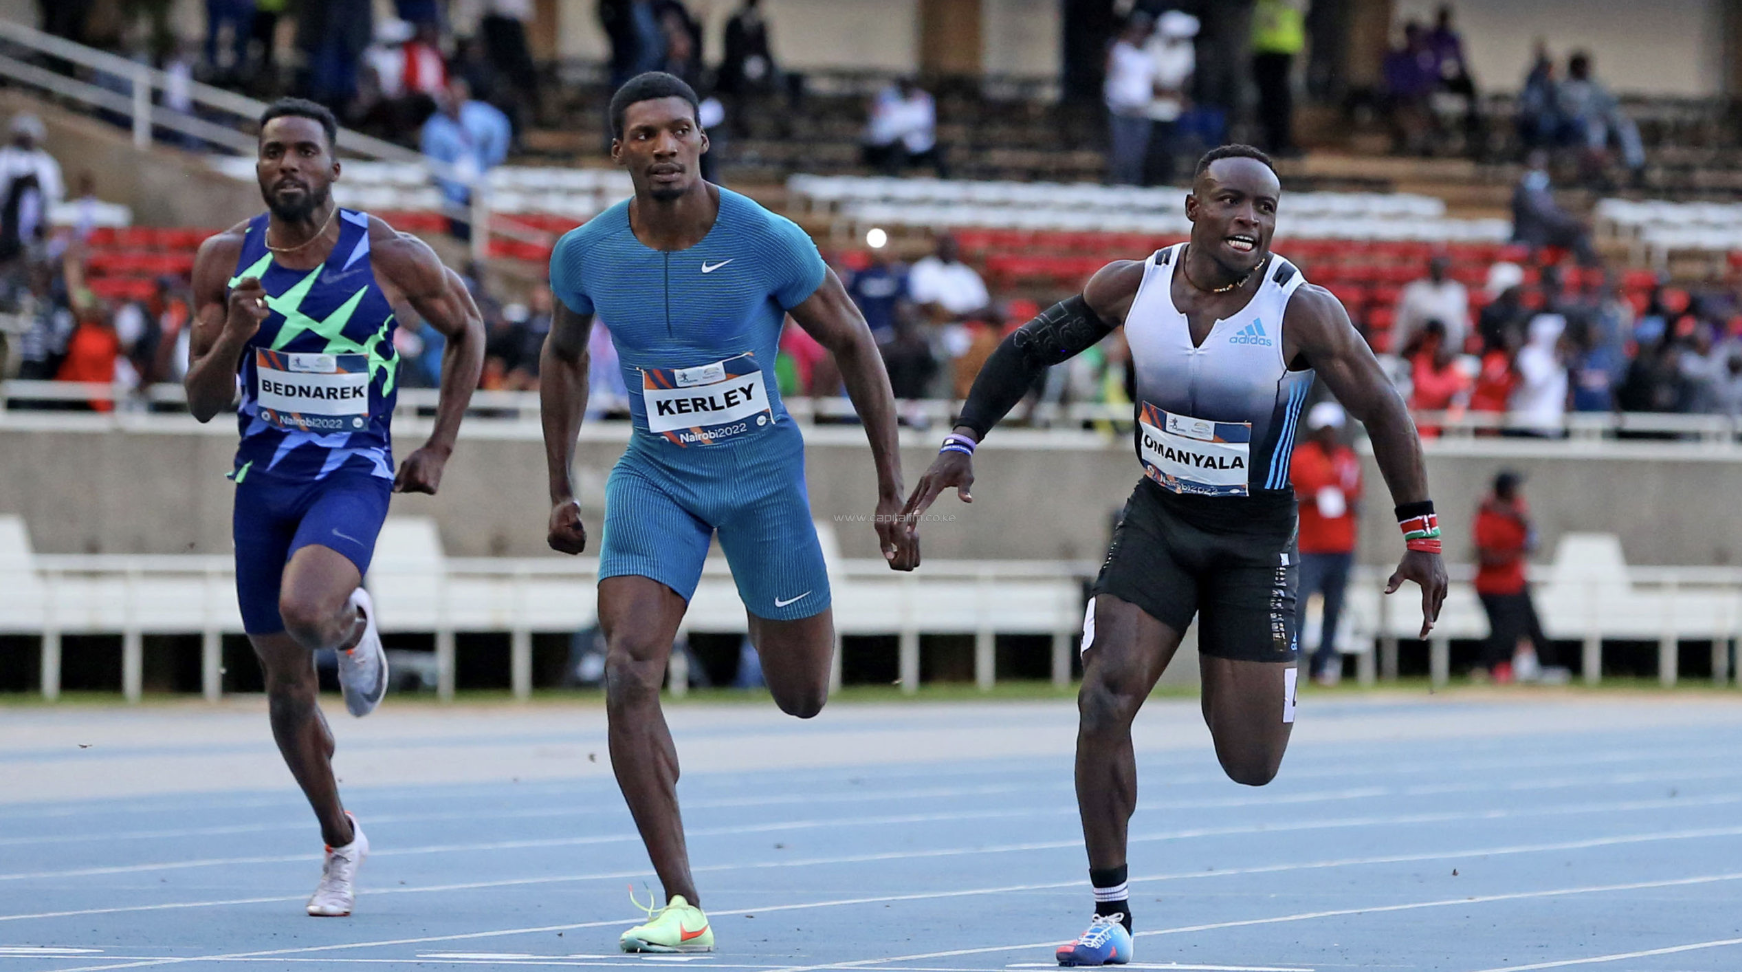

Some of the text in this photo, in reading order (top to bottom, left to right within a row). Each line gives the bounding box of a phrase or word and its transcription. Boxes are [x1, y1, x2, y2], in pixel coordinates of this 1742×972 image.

[1229, 335, 1272, 346] adidas
[262, 380, 364, 399] BEDNAREK
[656, 383, 754, 416] KERLEY
[280, 416, 343, 428] Nairobi2022
[680, 423, 747, 443] Nairobi2022
[1144, 435, 1244, 469] OMANYALA
